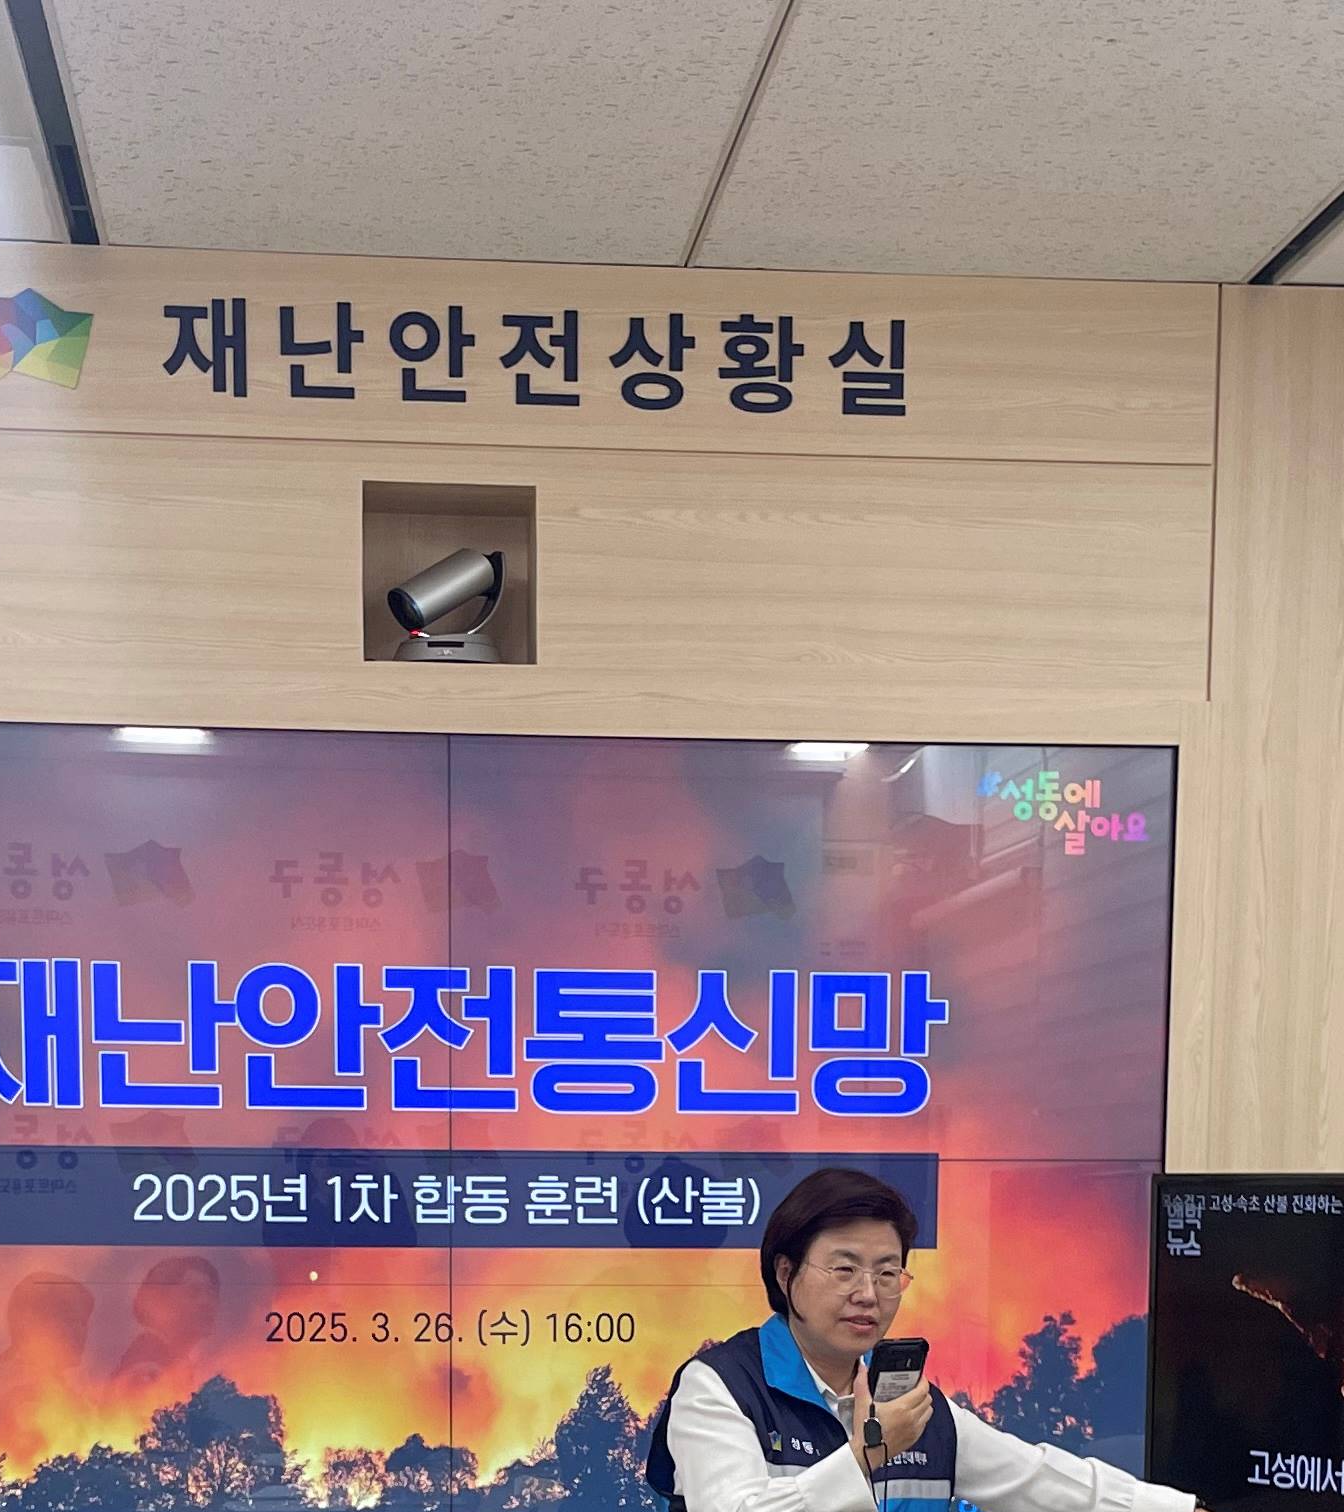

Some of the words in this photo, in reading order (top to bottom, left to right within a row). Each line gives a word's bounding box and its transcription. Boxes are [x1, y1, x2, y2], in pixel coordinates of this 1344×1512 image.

[162, 298, 909, 417] 재난안전상황실
[1054, 810, 1149, 855] 살아요
[133, 1172, 309, 1224] 2025년
[325, 1175, 399, 1225] 1차
[412, 1175, 510, 1226] 합동
[524, 1175, 620, 1226] 훈련
[637, 1176, 761, 1227] (산불)
[1264, 1195, 1288, 1214] 산불
[1292, 1195, 1343, 1215] 진화하는
[1167, 1231, 1202, 1256] 뉴스
[265, 1313, 359, 1343] 2025.
[371, 1313, 399, 1343] 3.
[413, 1313, 464, 1343] 26.
[477, 1311, 532, 1347] (수)
[546, 1313, 635, 1344] 16:00
